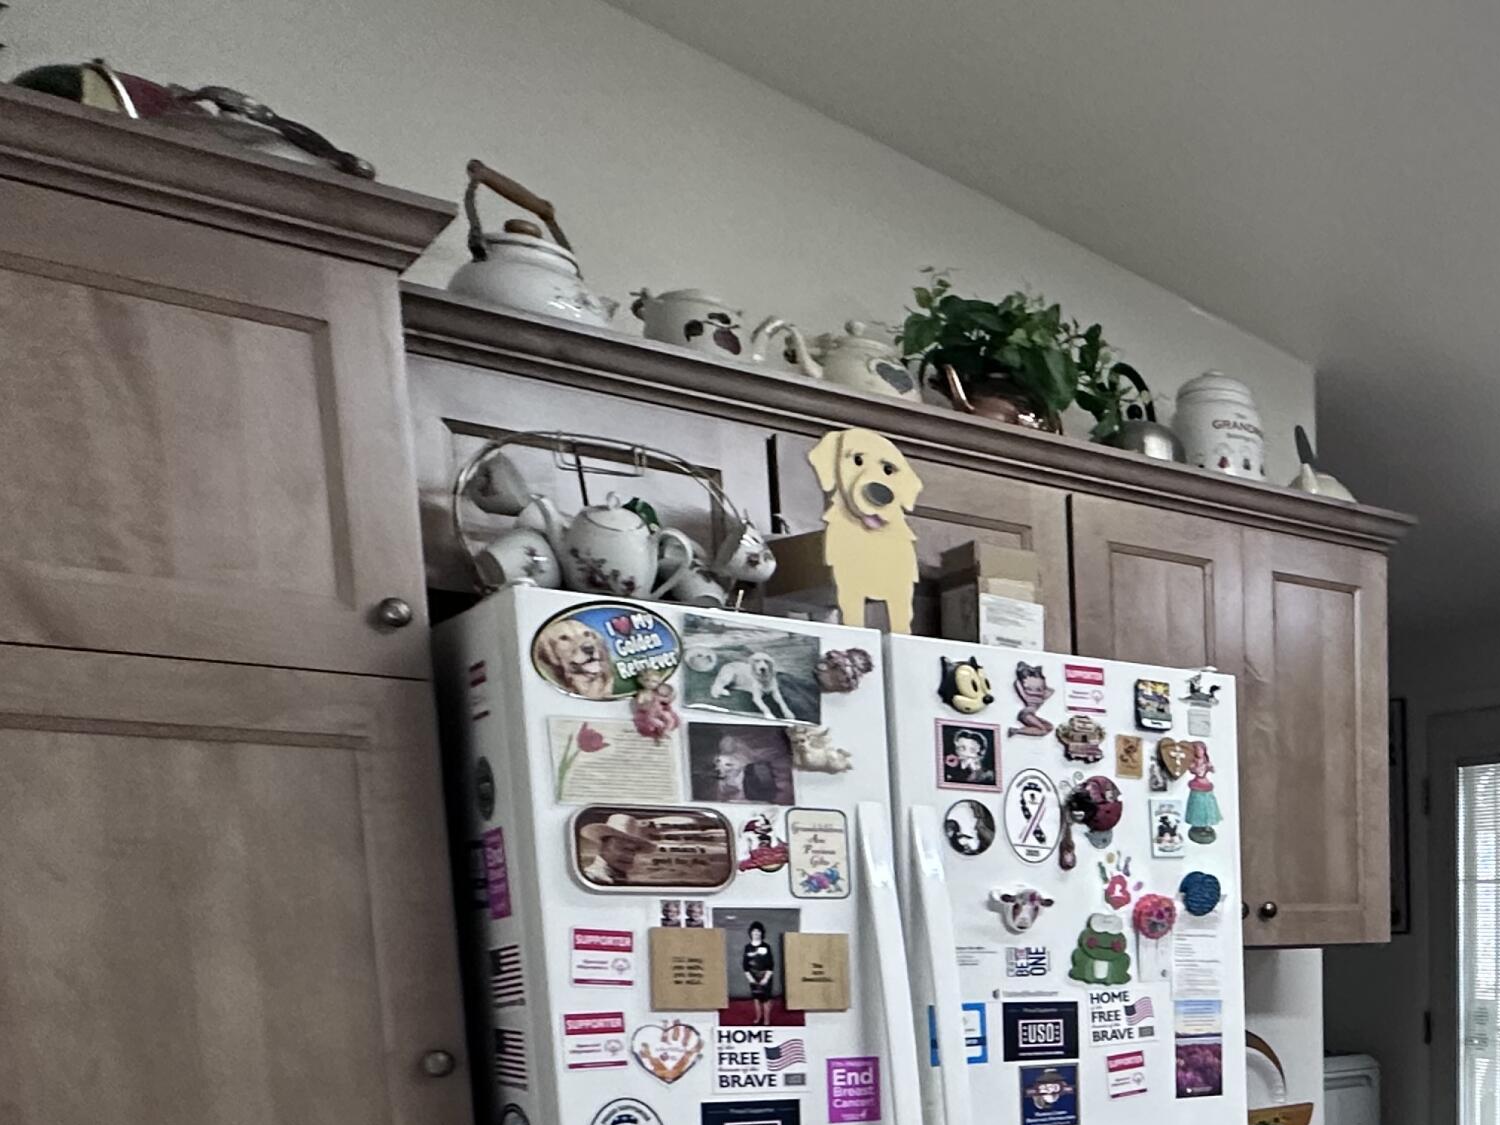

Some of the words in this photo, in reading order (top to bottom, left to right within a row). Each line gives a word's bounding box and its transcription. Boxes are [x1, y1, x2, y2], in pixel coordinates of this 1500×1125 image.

[605, 621, 615, 636] I
[615, 633, 662, 656] Golden
[616, 652, 678, 679] Retriever
[1029, 947, 1047, 976] ONE
[1090, 989, 1130, 1004] HOME
[1091, 1010, 1121, 1023] FREE
[717, 1030, 773, 1043] HOME
[1027, 1023, 1054, 1043] USO
[1092, 1028, 1134, 1042] BRAVE
[718, 1052, 760, 1065] FREE
[718, 1074, 777, 1088] BRAVE
[832, 1067, 873, 1086] End
[833, 1086, 874, 1097] Breast
